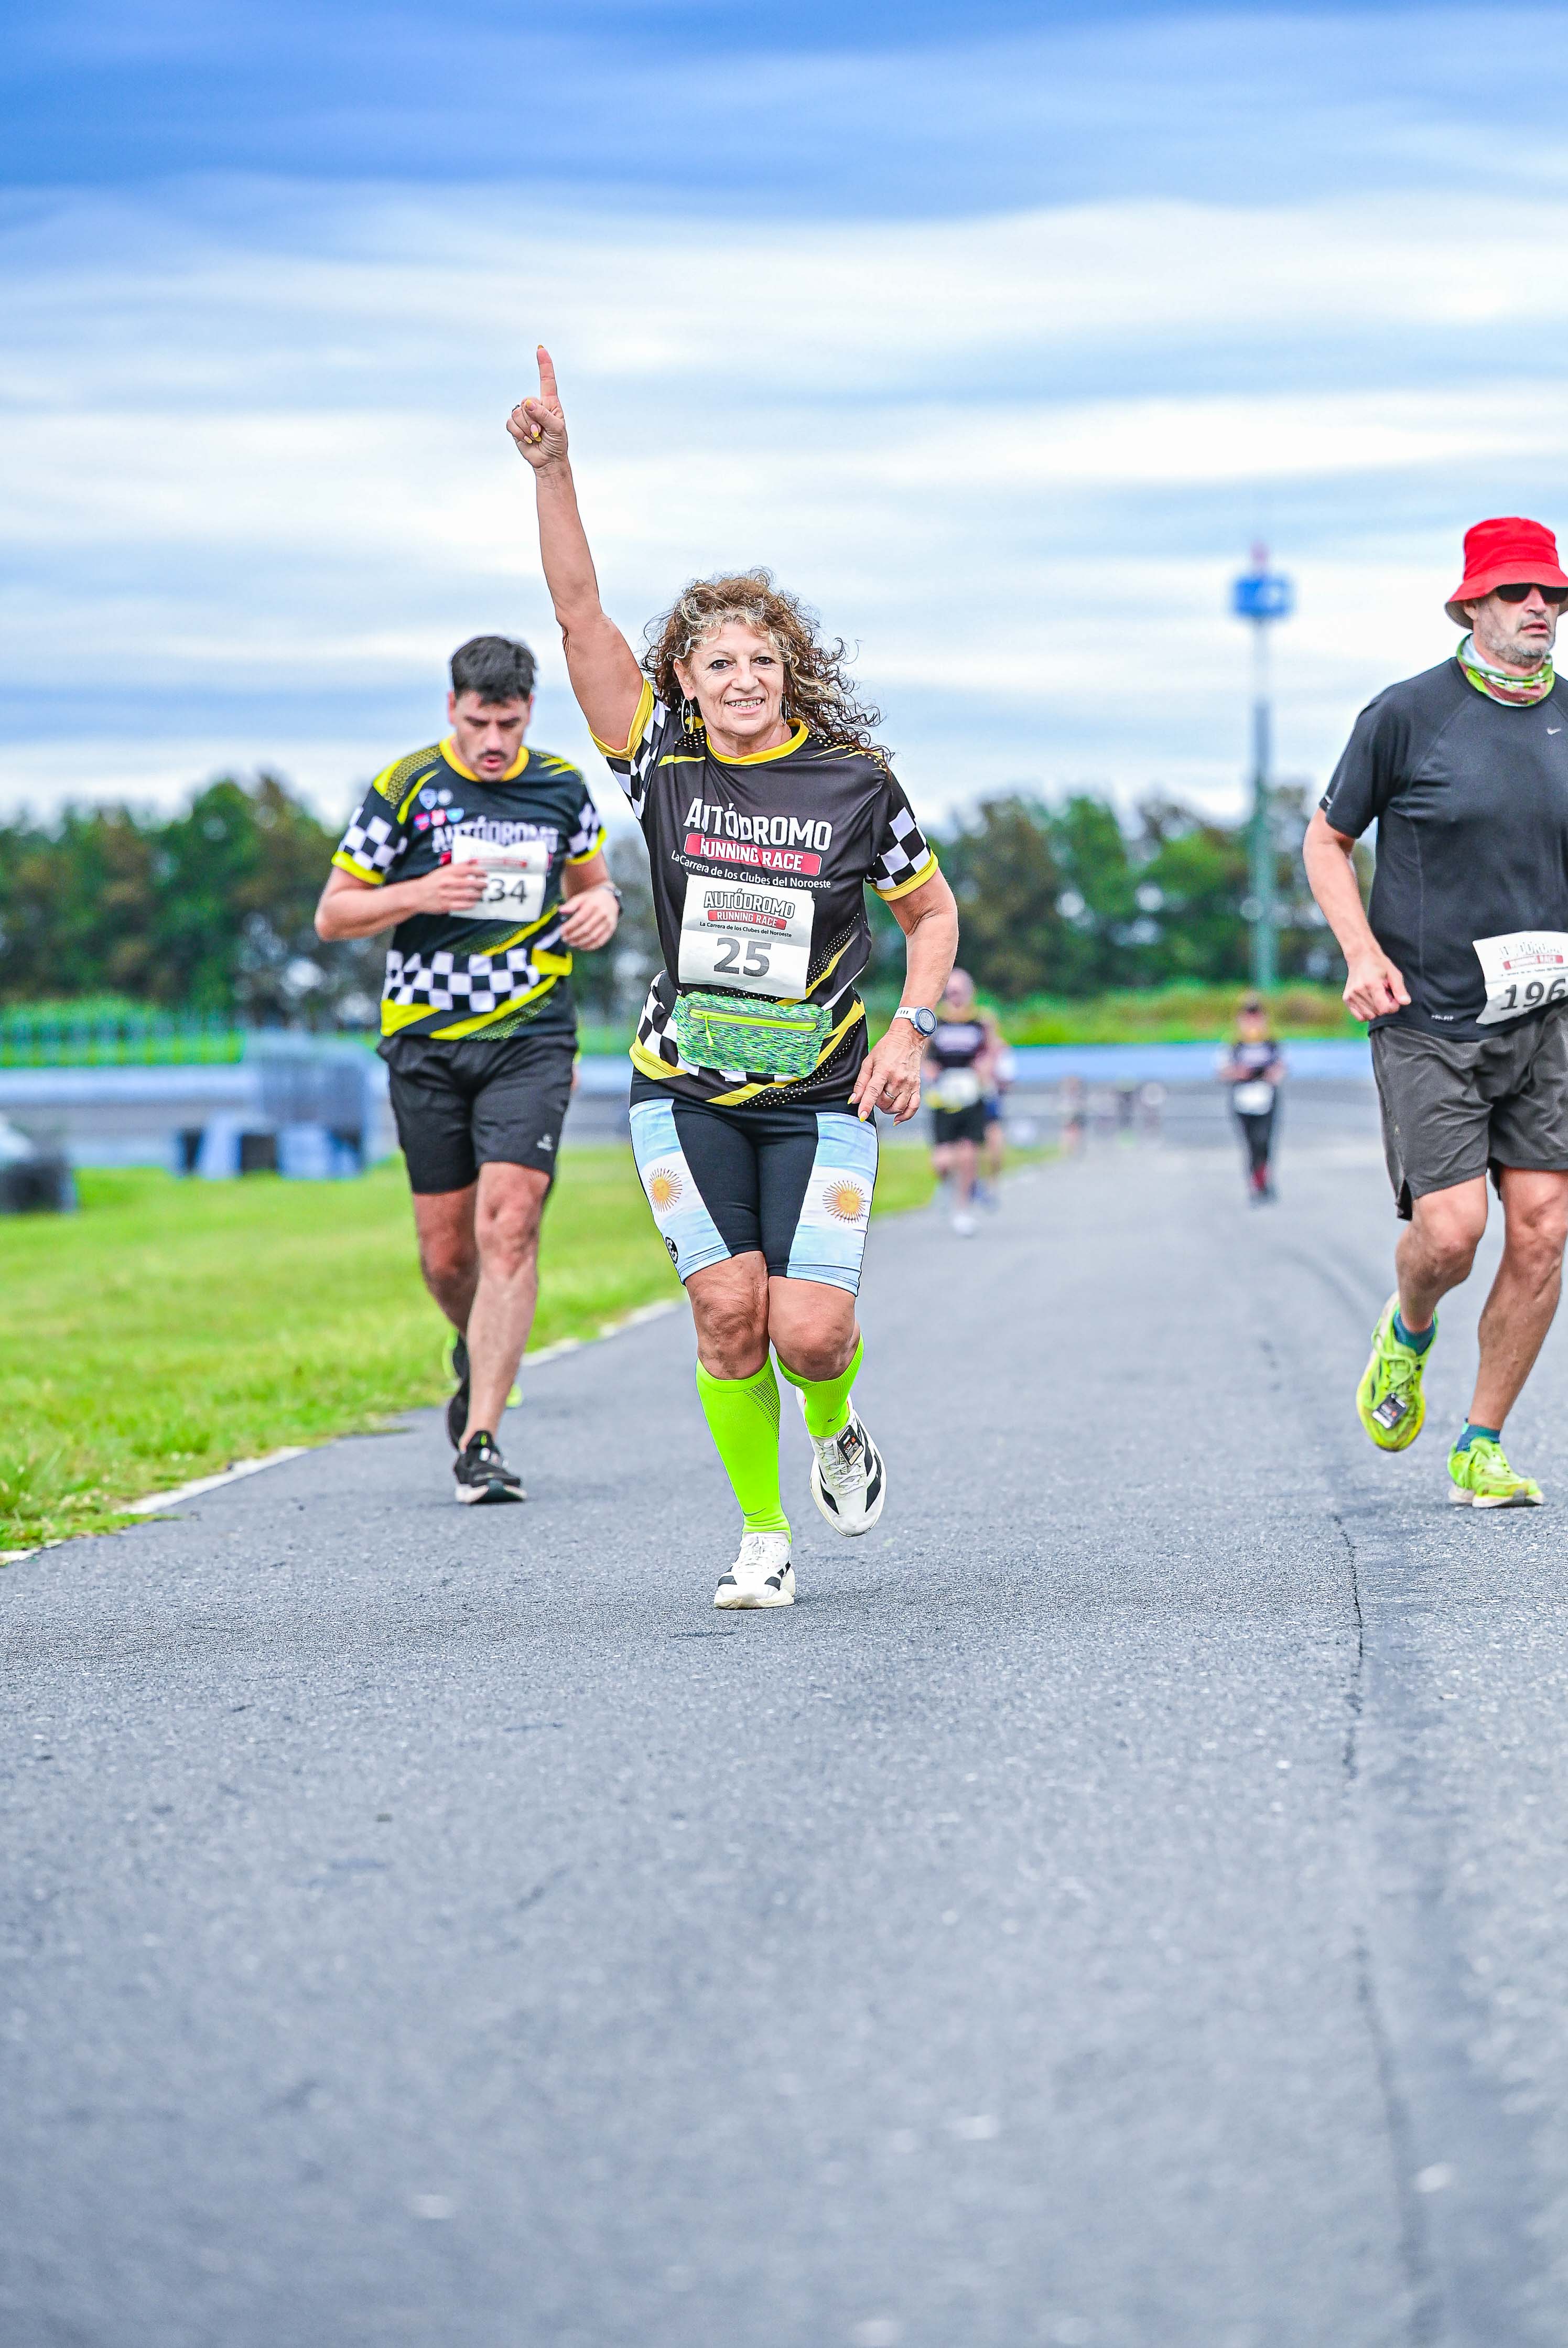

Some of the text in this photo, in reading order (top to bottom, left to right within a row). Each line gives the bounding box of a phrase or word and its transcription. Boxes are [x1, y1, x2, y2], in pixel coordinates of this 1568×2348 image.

[762, 851, 804, 871] RACE
[710, 866, 723, 877] de
[724, 868, 738, 880] los
[740, 871, 770, 885] Clubes
[772, 876, 787, 887] del
[790, 877, 831, 888] Noroeste
[474, 878, 527, 903] 34
[704, 888, 796, 919] AUTÓDROMO
[717, 911, 778, 927] RUNNING RACE
[714, 938, 772, 977] 25
[1500, 978, 1566, 1010] 196
